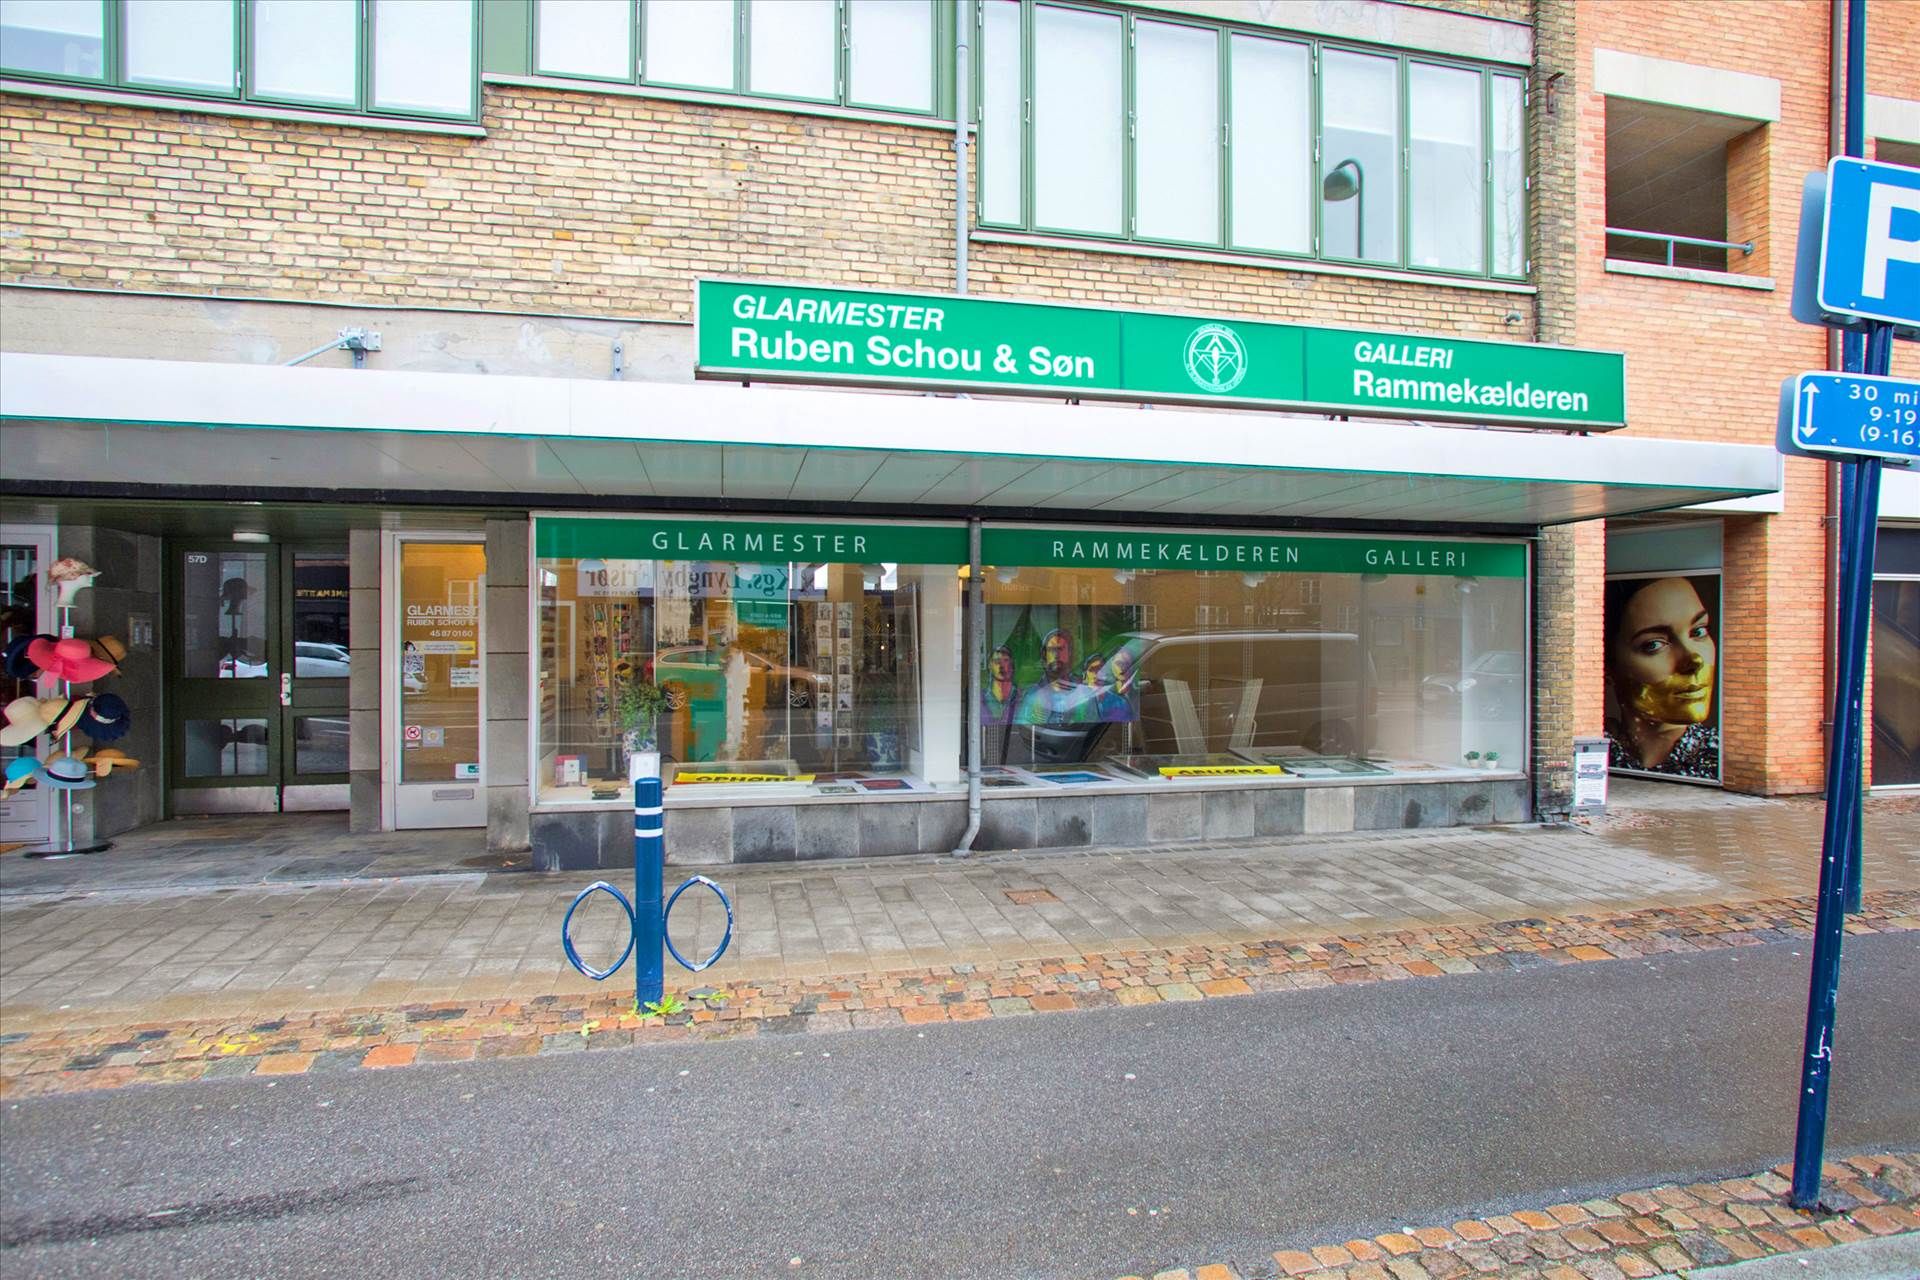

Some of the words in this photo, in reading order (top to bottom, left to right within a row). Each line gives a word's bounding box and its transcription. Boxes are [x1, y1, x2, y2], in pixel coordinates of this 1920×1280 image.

[1862, 182, 1920, 299] P
[733, 294, 944, 331] GLARMESTER
[731, 327, 854, 364] Ruben
[866, 336, 981, 371] Schou
[993, 344, 1018, 374] &
[1029, 347, 1094, 379] Søn
[1354, 341, 1454, 369] GALLERI
[1353, 369, 1588, 412] Rammekælderen
[1848, 384, 1878, 401] 30
[1894, 391, 1920, 405] mi
[1869, 406, 1917, 425] 9-19
[653, 532, 867, 553] GLARMESTER
[1053, 540, 1300, 564] RAMMEKÆLDEREN
[1366, 548, 1468, 568] GALLERI
[187, 555, 208, 564] 57D
